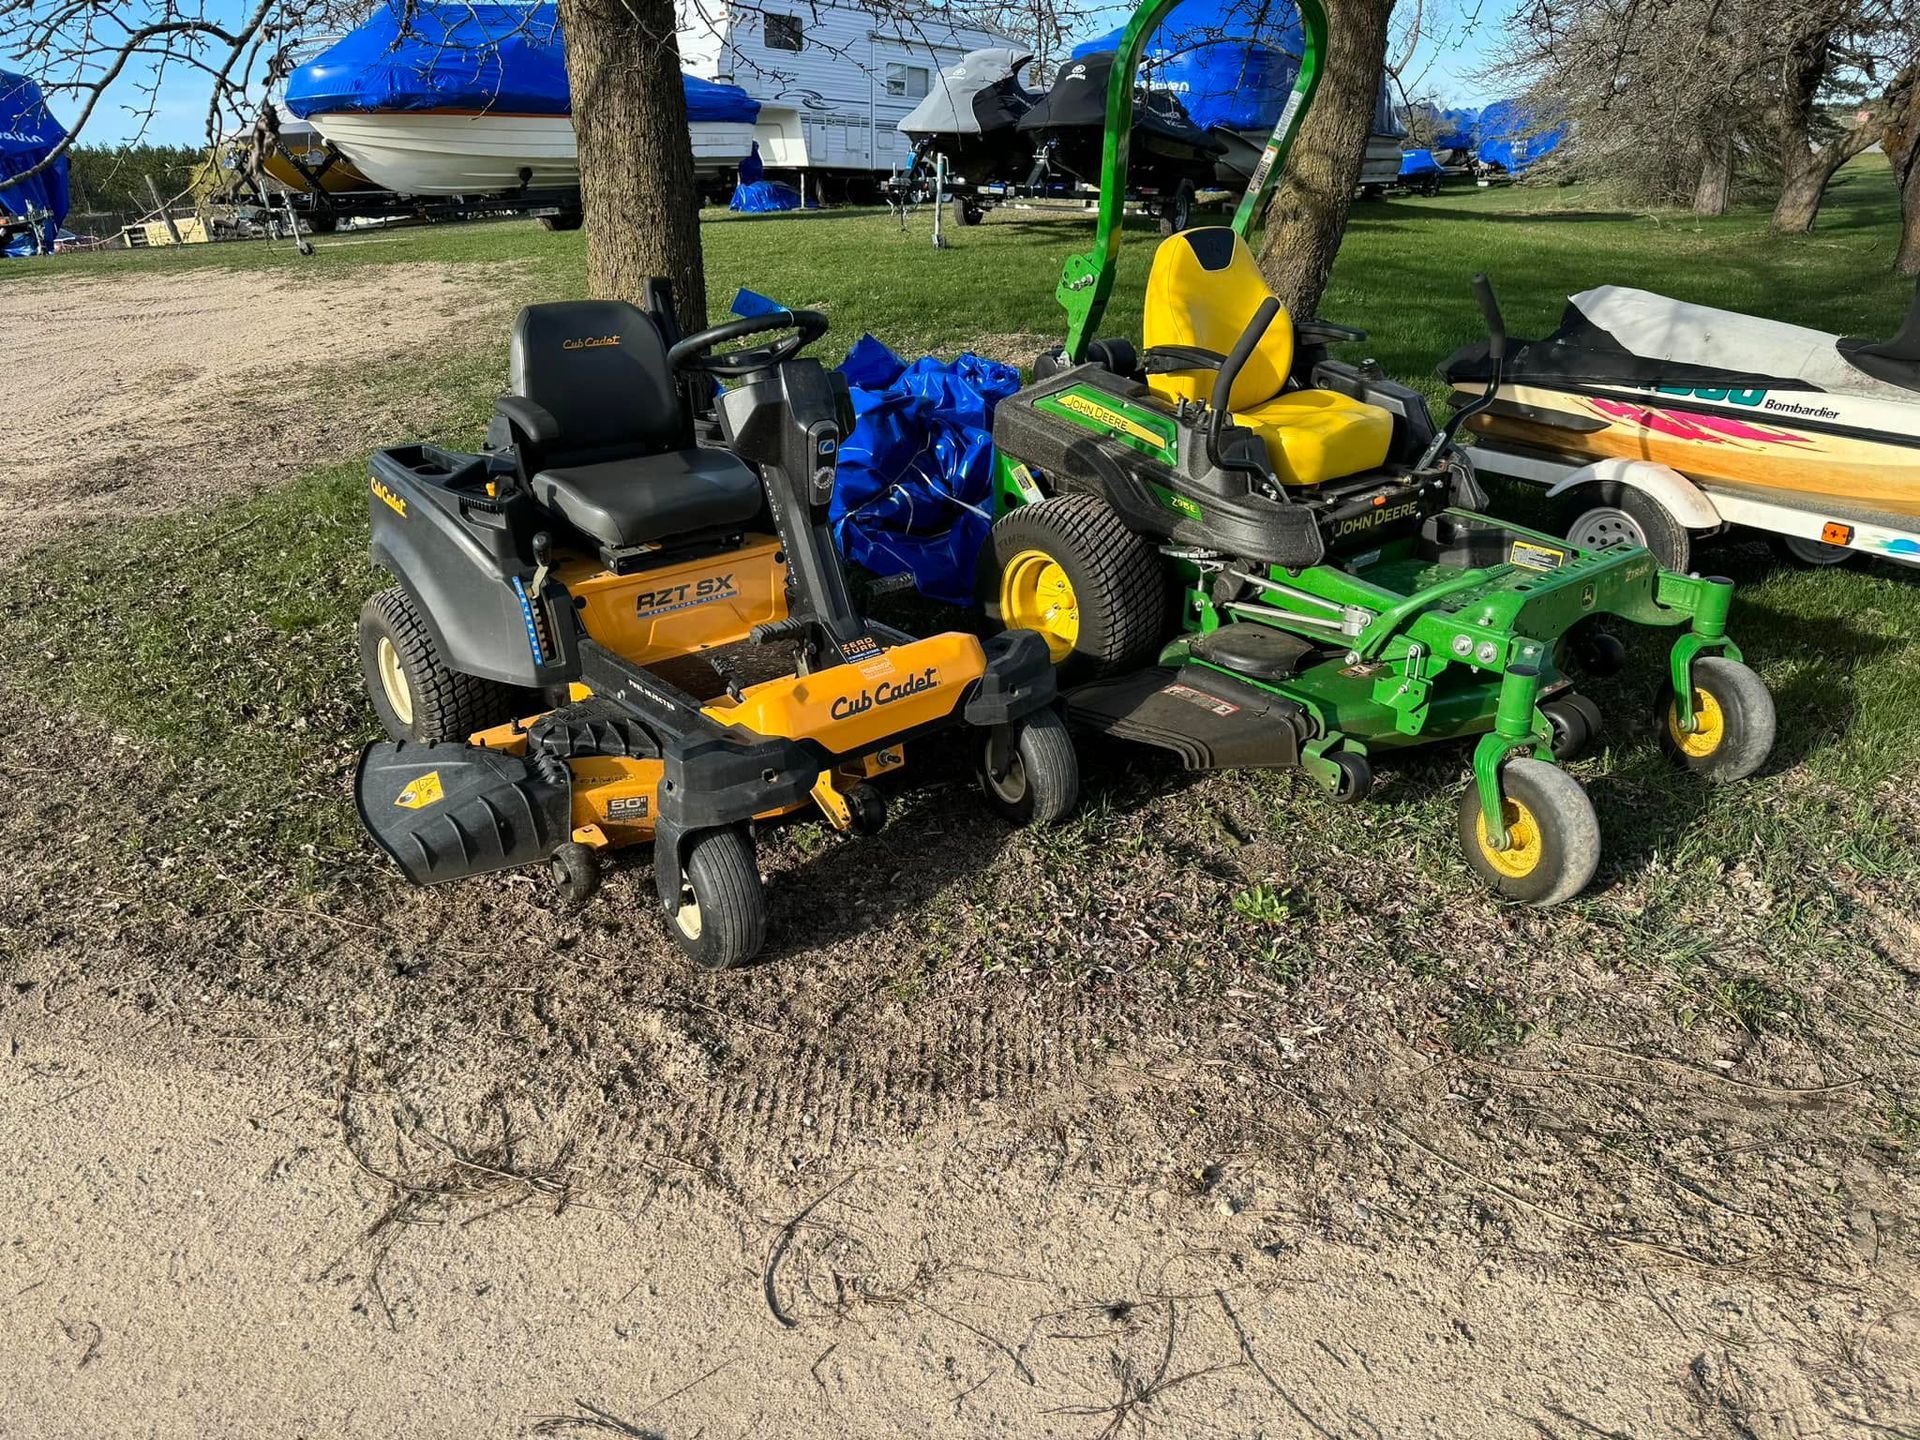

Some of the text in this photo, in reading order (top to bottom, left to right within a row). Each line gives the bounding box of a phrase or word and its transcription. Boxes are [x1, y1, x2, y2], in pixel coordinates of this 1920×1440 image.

[563, 335, 621, 349] Cub Cadet
[1067, 397, 1129, 431] JOHN DEERE
[1764, 399, 1840, 420] Bombardier
[371, 476, 407, 519] Cub Cadet
[1335, 500, 1418, 538] JOHN DEERE
[637, 573, 734, 612] RZT SX
[841, 637, 873, 651] ZERO
[844, 643, 877, 656] TURN
[831, 689, 873, 720] Cub
[875, 667, 938, 705] Cadet
